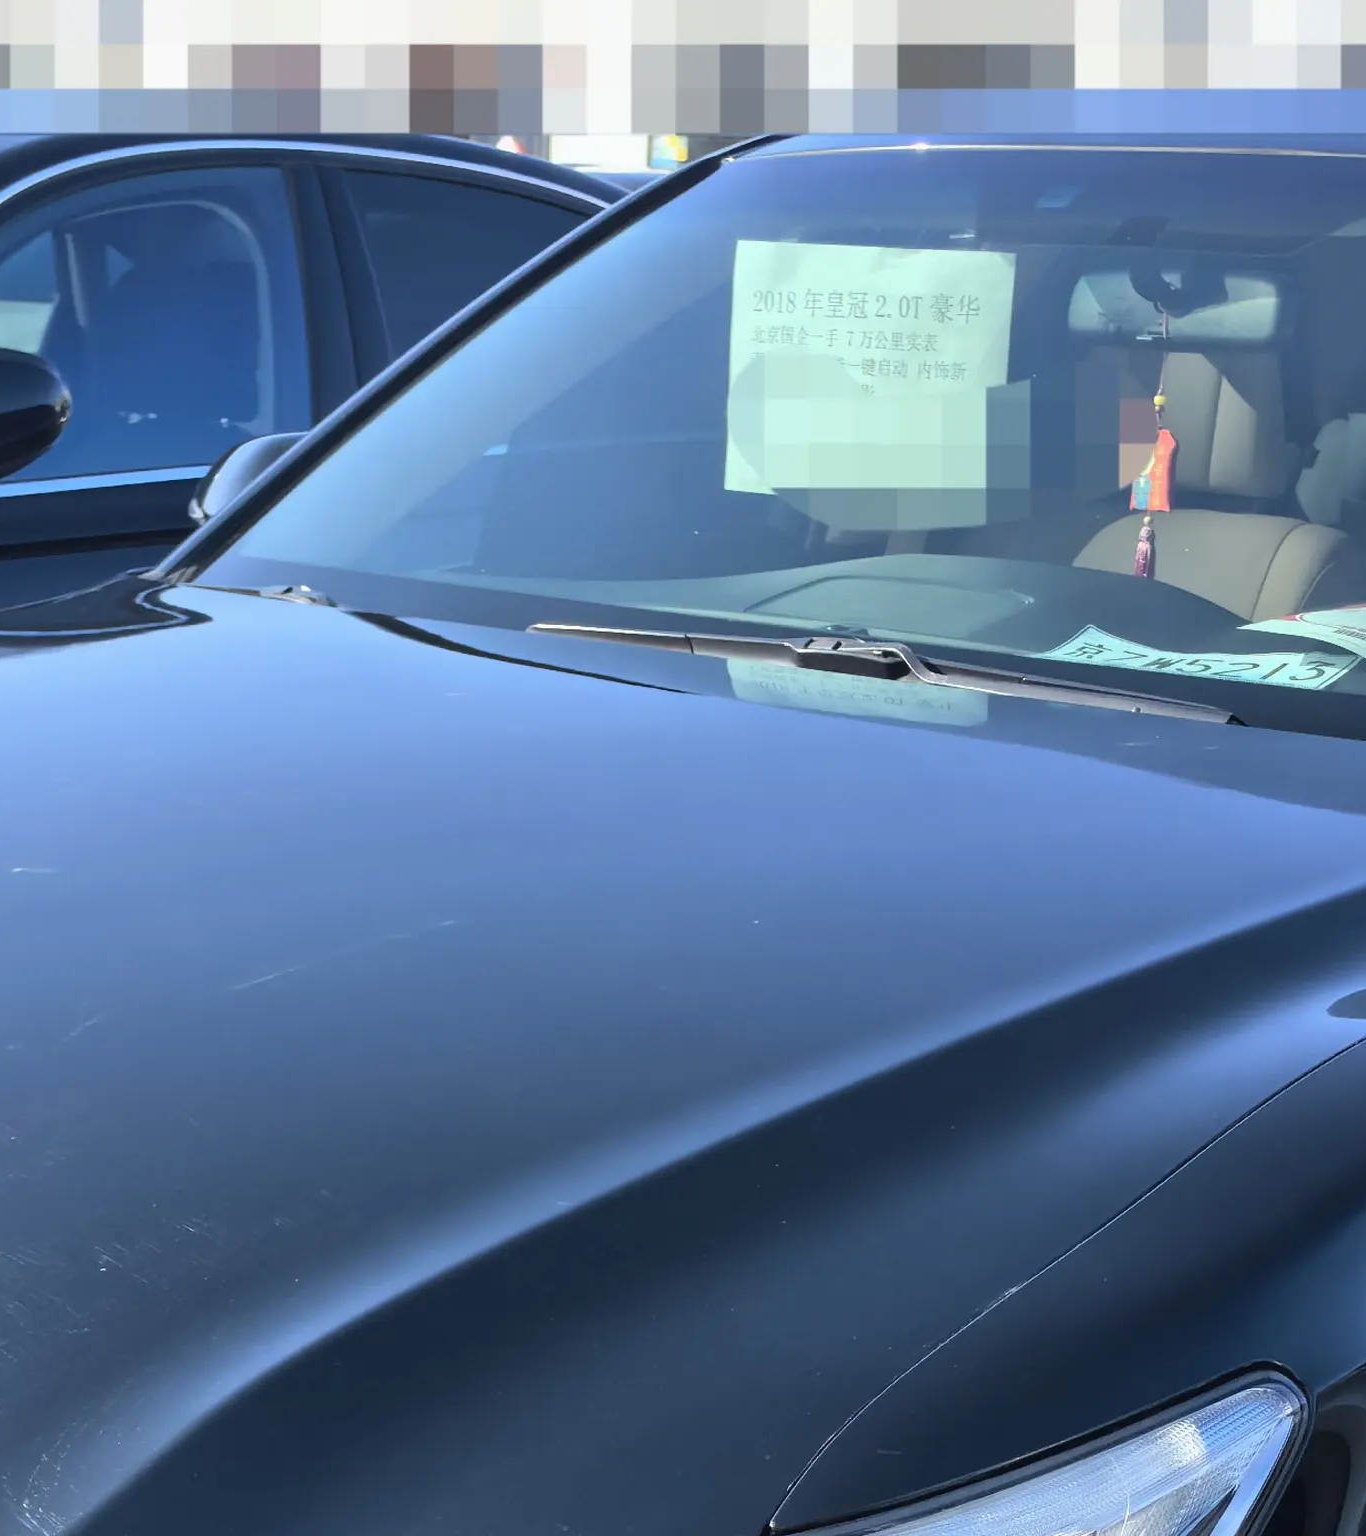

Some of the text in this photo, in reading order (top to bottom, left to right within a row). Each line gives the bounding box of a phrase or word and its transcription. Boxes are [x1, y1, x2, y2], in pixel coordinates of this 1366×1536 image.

[751, 288, 981, 324] 2018 年皇冠 2.0T 豪华
